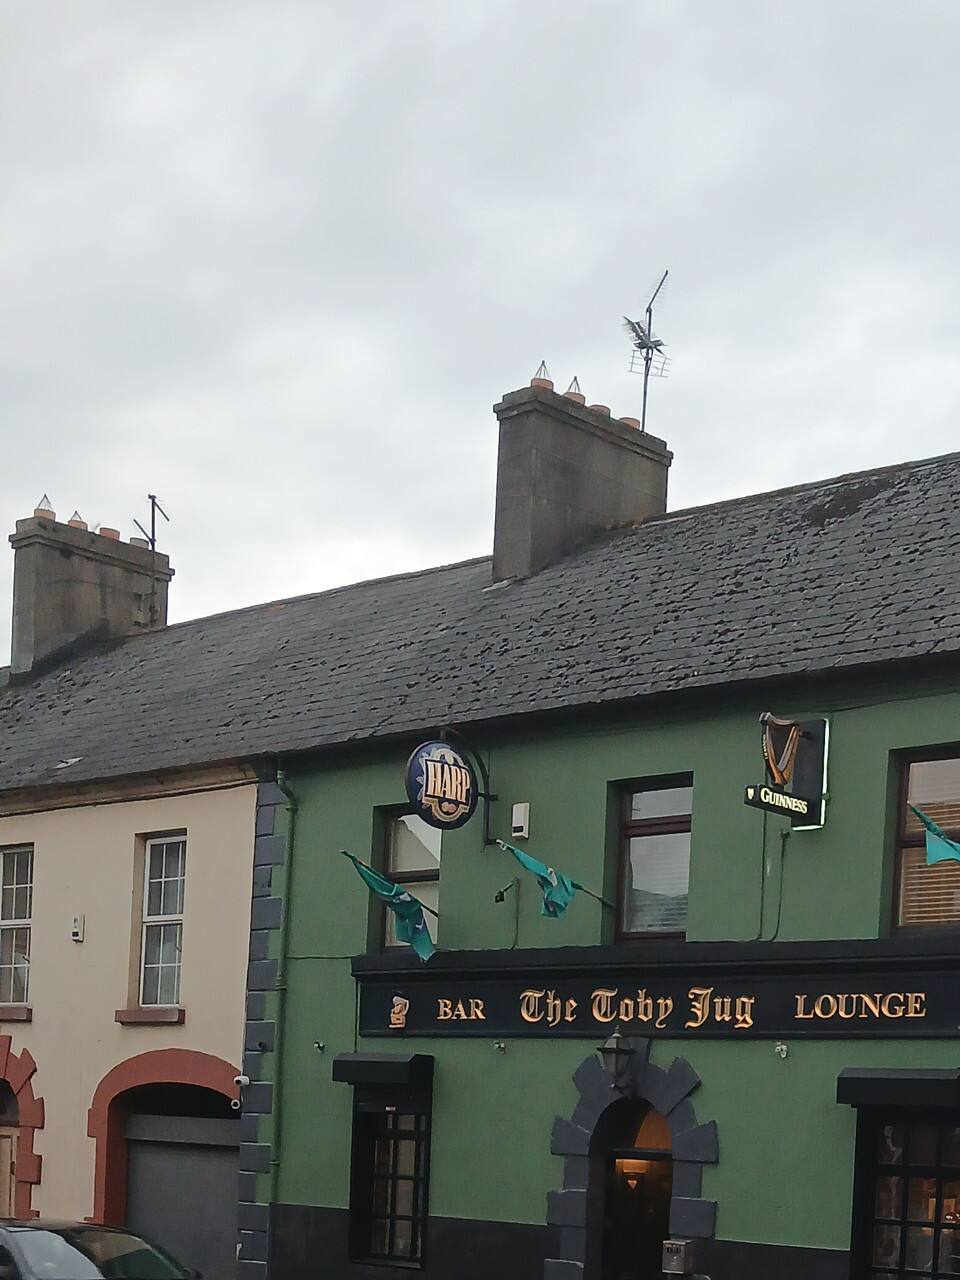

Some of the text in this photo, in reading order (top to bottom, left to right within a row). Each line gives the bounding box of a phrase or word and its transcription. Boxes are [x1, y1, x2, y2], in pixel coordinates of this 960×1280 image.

[426, 760, 471, 803] HARP
[759, 787, 808, 814] GUINNESS
[437, 986, 927, 1029] BAR The Toby Jug LOUNGE
